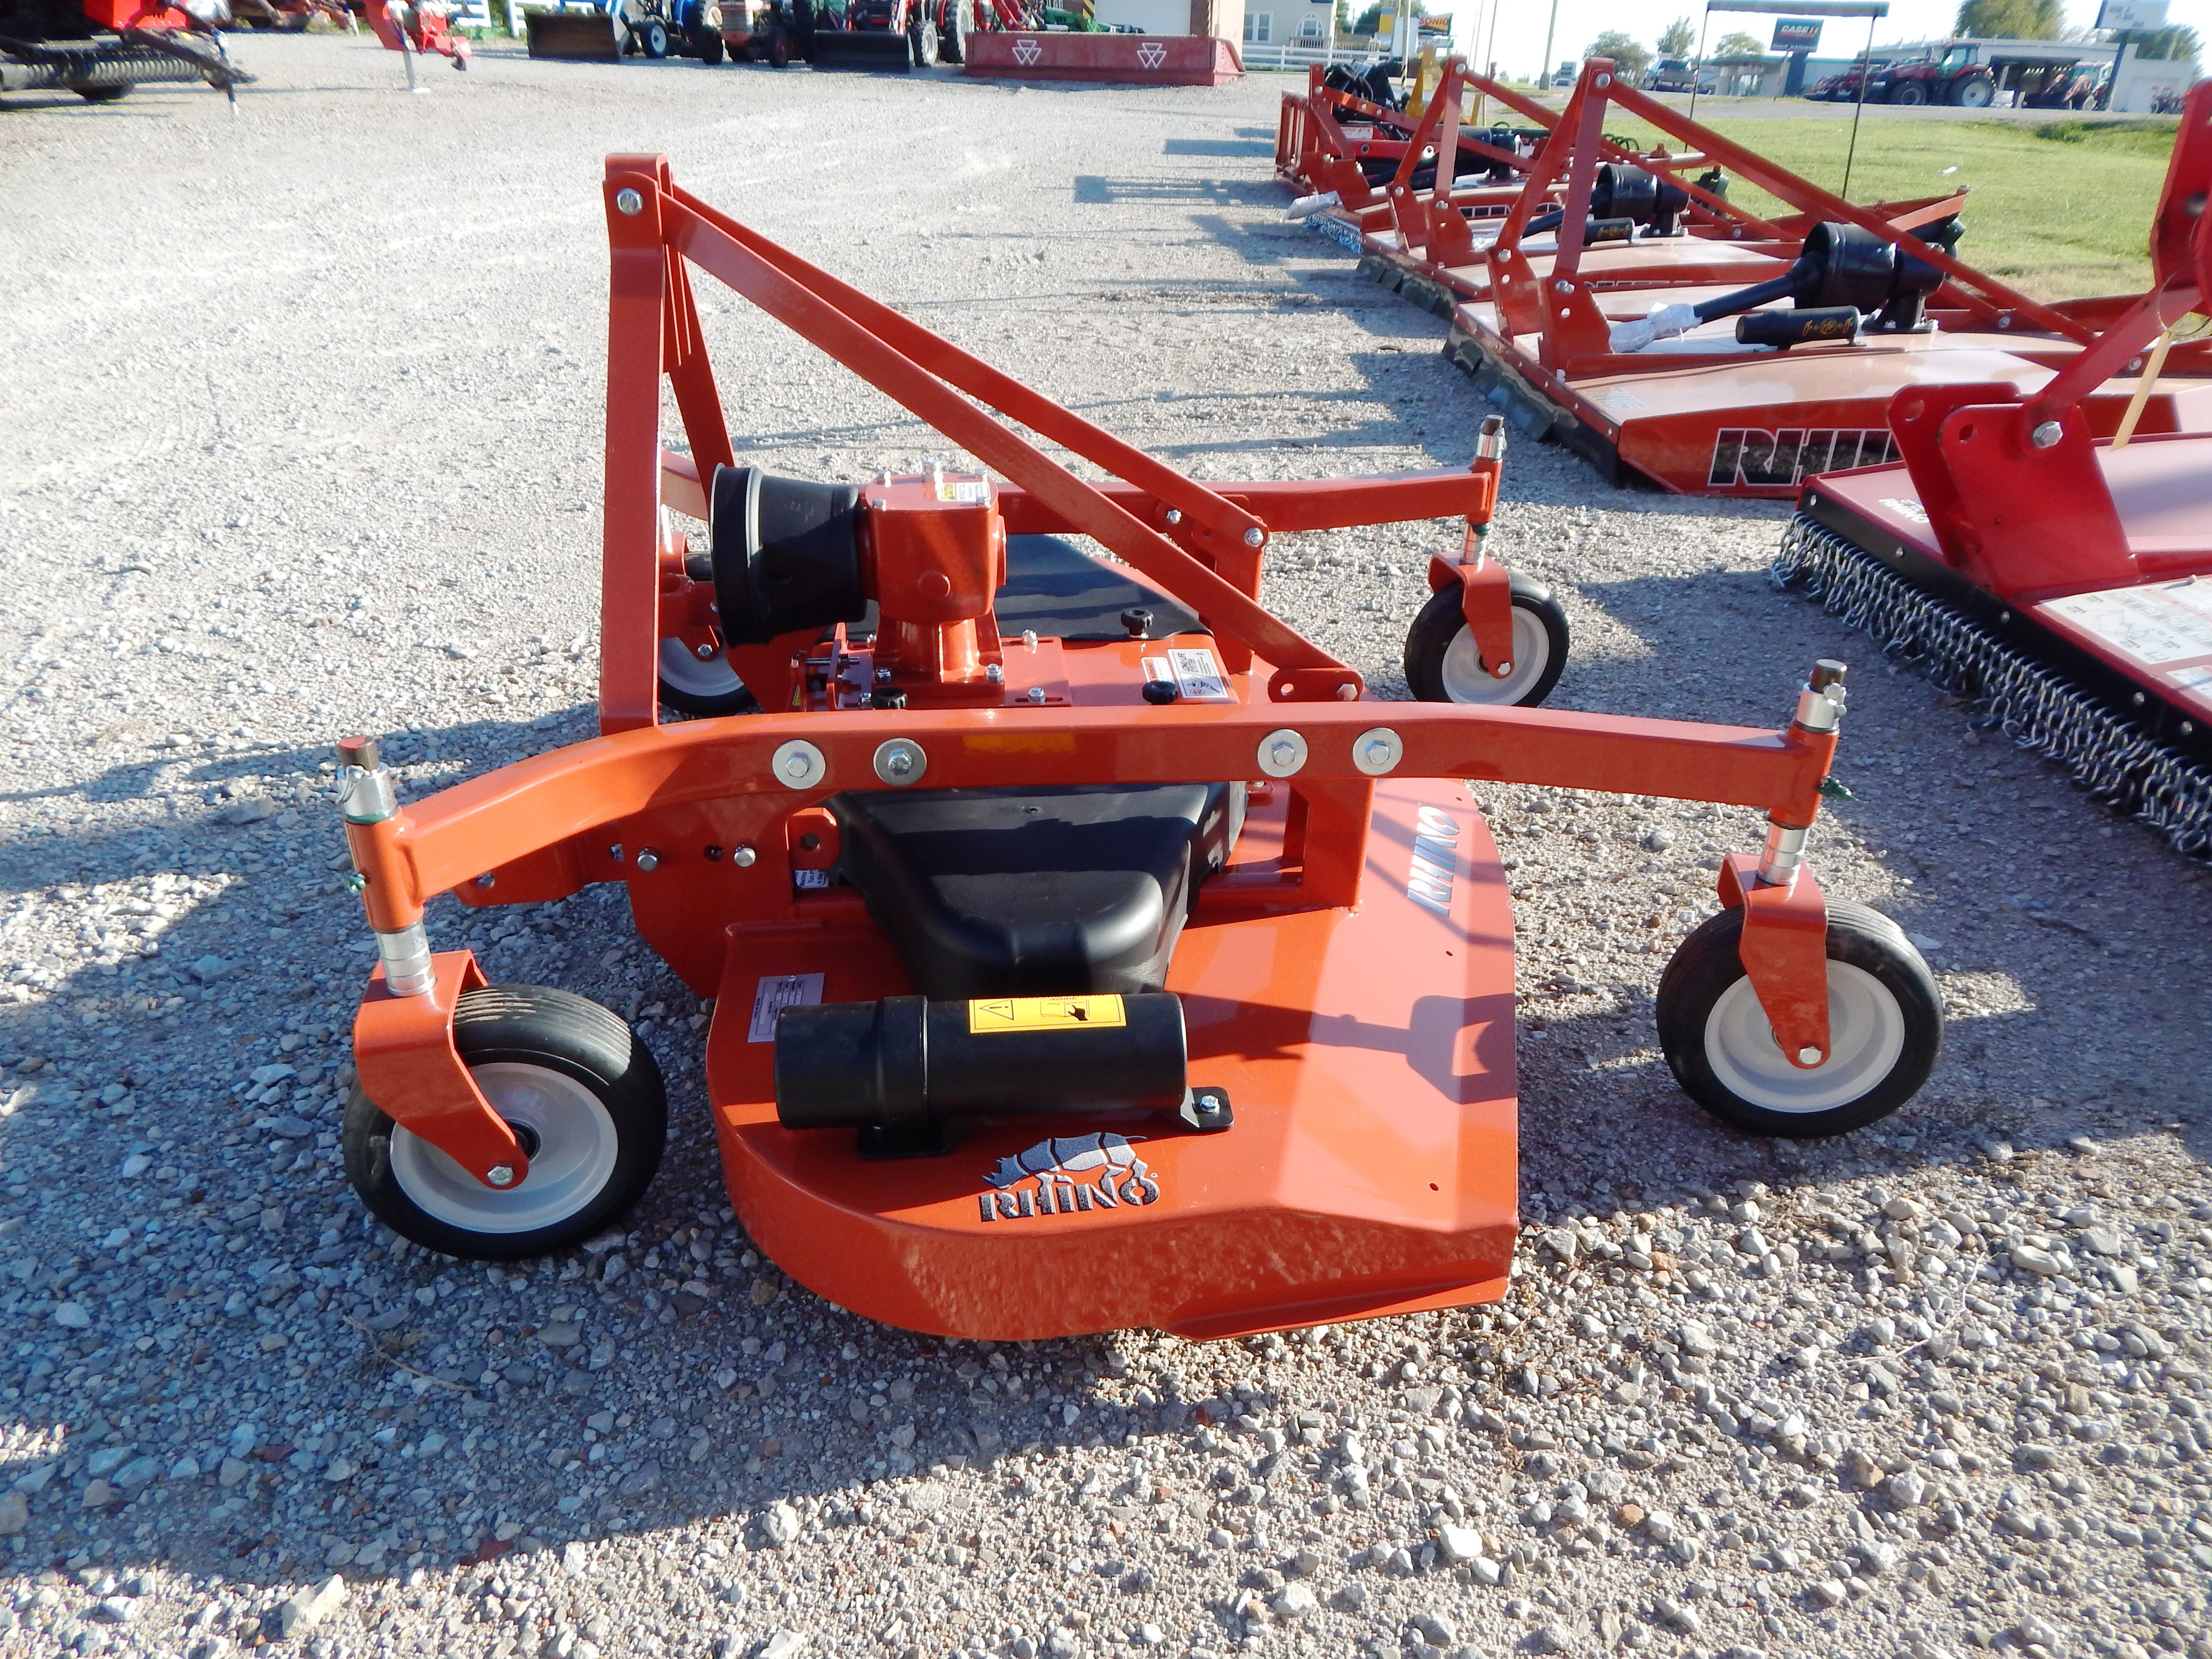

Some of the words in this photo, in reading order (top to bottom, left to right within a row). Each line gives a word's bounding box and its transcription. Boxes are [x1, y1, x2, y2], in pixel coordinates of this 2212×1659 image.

[1419, 17, 1448, 26] SONIC
[1407, 806, 1460, 917] RHINO
[978, 1178, 1161, 1224] RHINO
